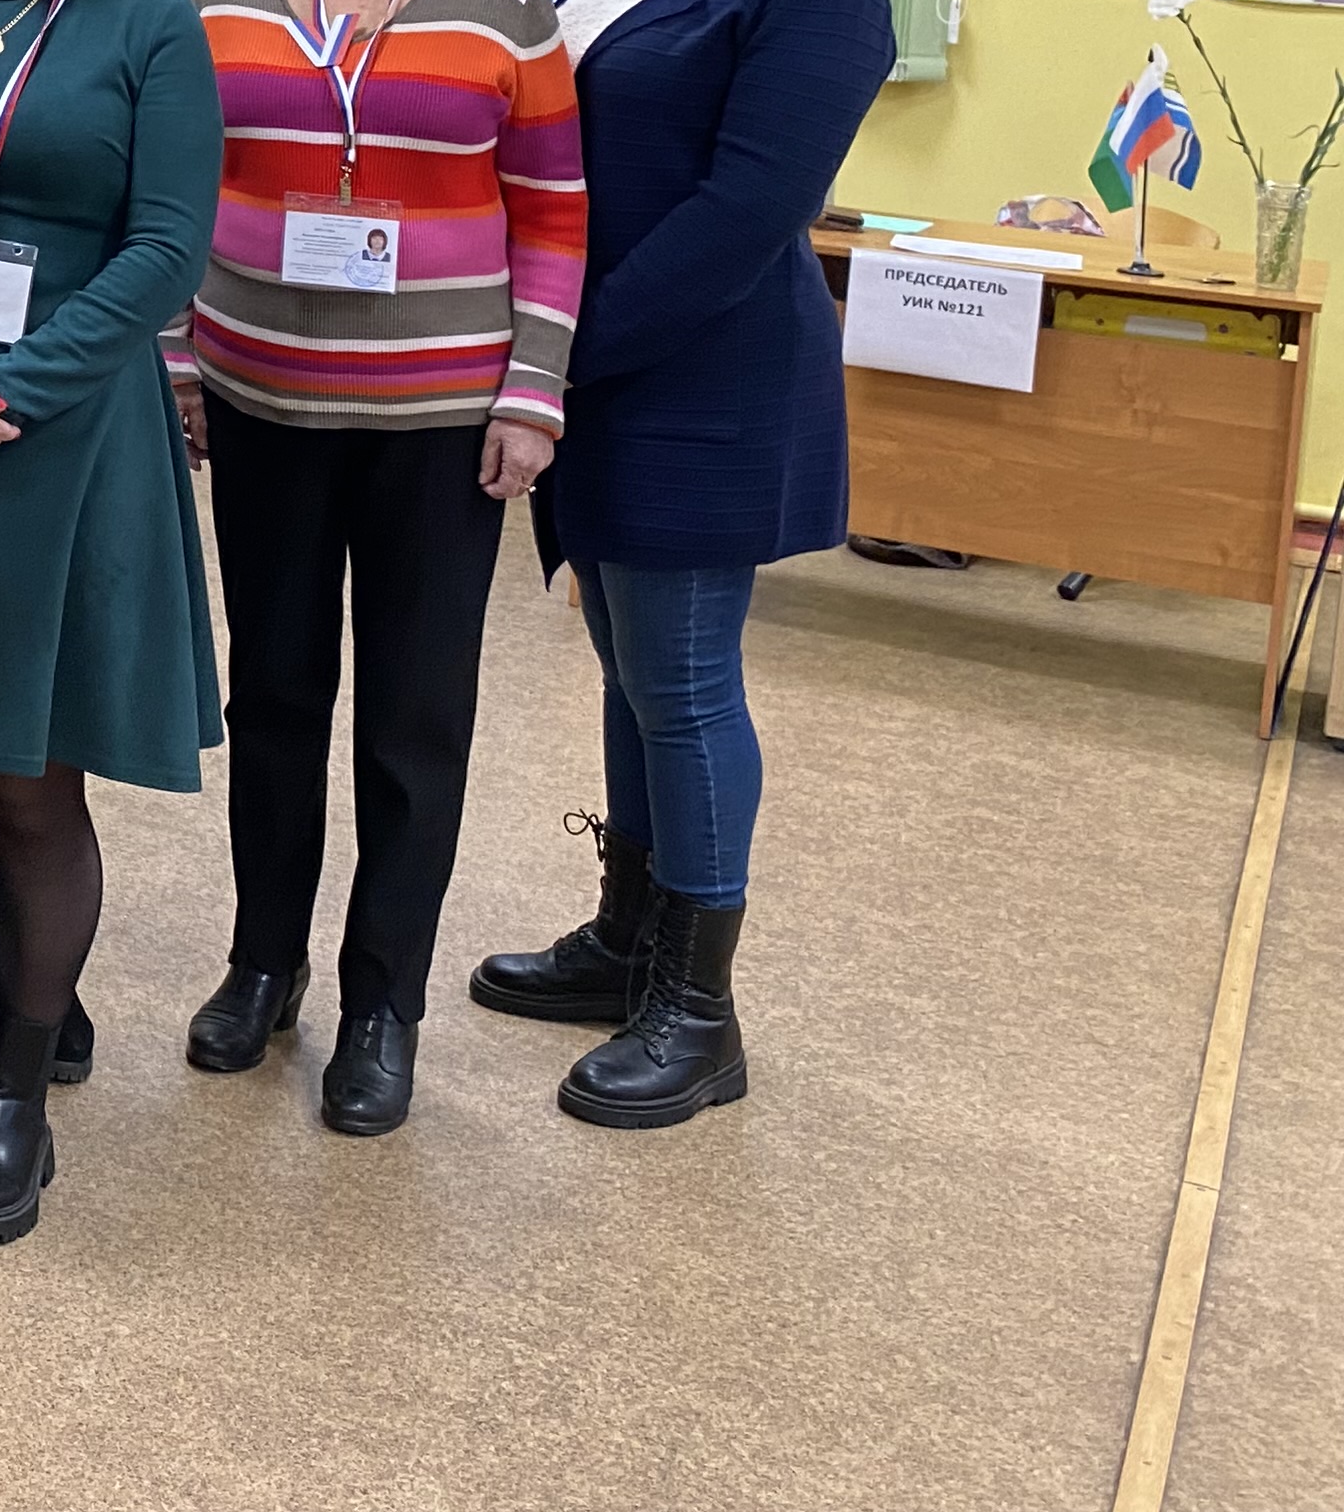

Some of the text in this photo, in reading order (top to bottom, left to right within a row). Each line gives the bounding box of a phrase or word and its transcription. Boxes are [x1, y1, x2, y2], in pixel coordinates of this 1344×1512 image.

[885, 268, 1008, 296] ПРЕДСЕДАТЕЛЬ
[902, 294, 985, 317] УИК №121
